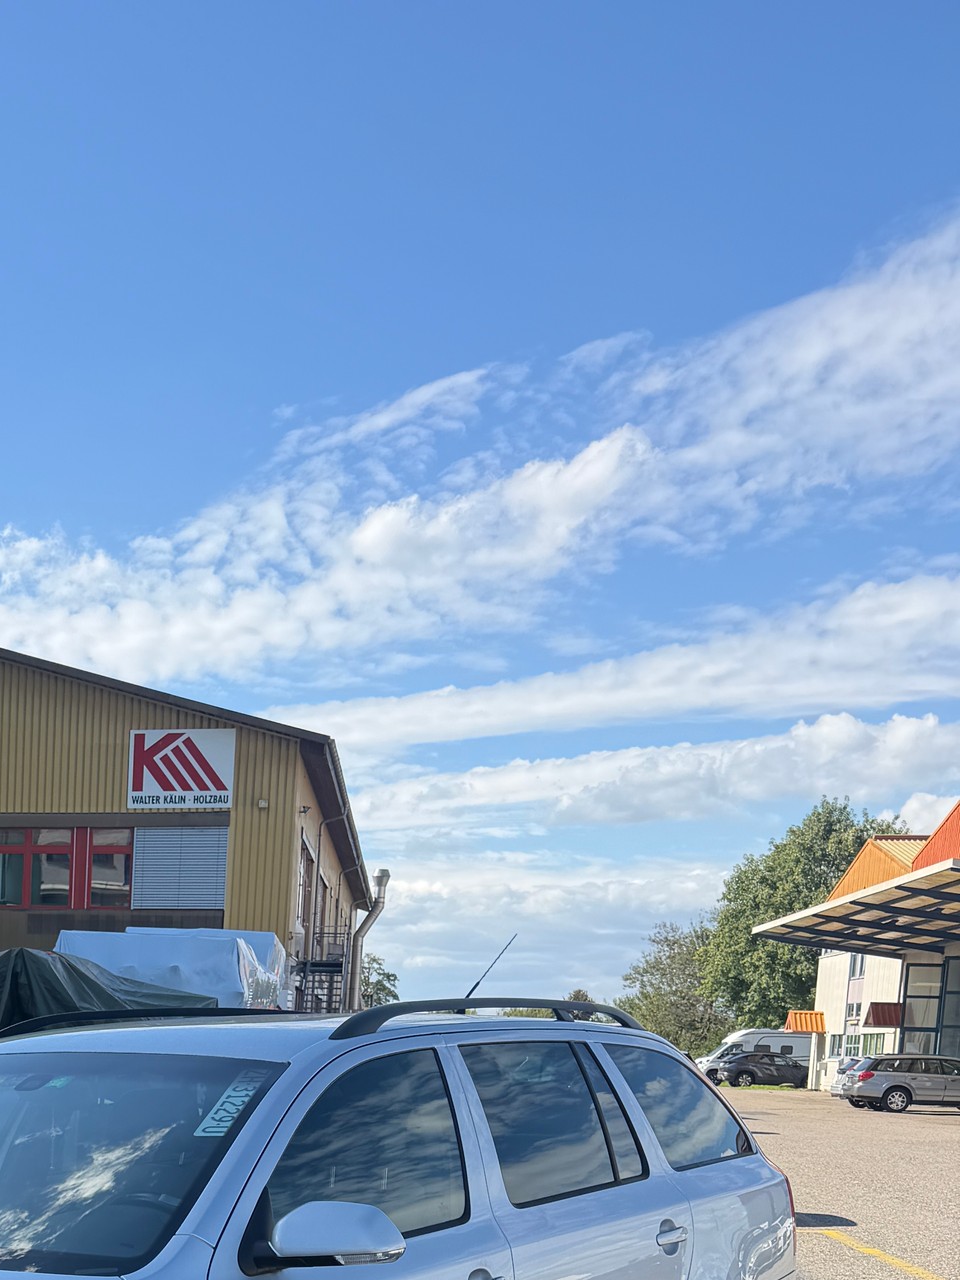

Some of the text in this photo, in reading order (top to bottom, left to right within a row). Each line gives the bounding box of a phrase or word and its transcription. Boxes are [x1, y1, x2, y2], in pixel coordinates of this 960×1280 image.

[131, 795, 161, 804] WALTER
[163, 793, 186, 804] KÄLIN
[193, 795, 229, 804] HOLZBAU
